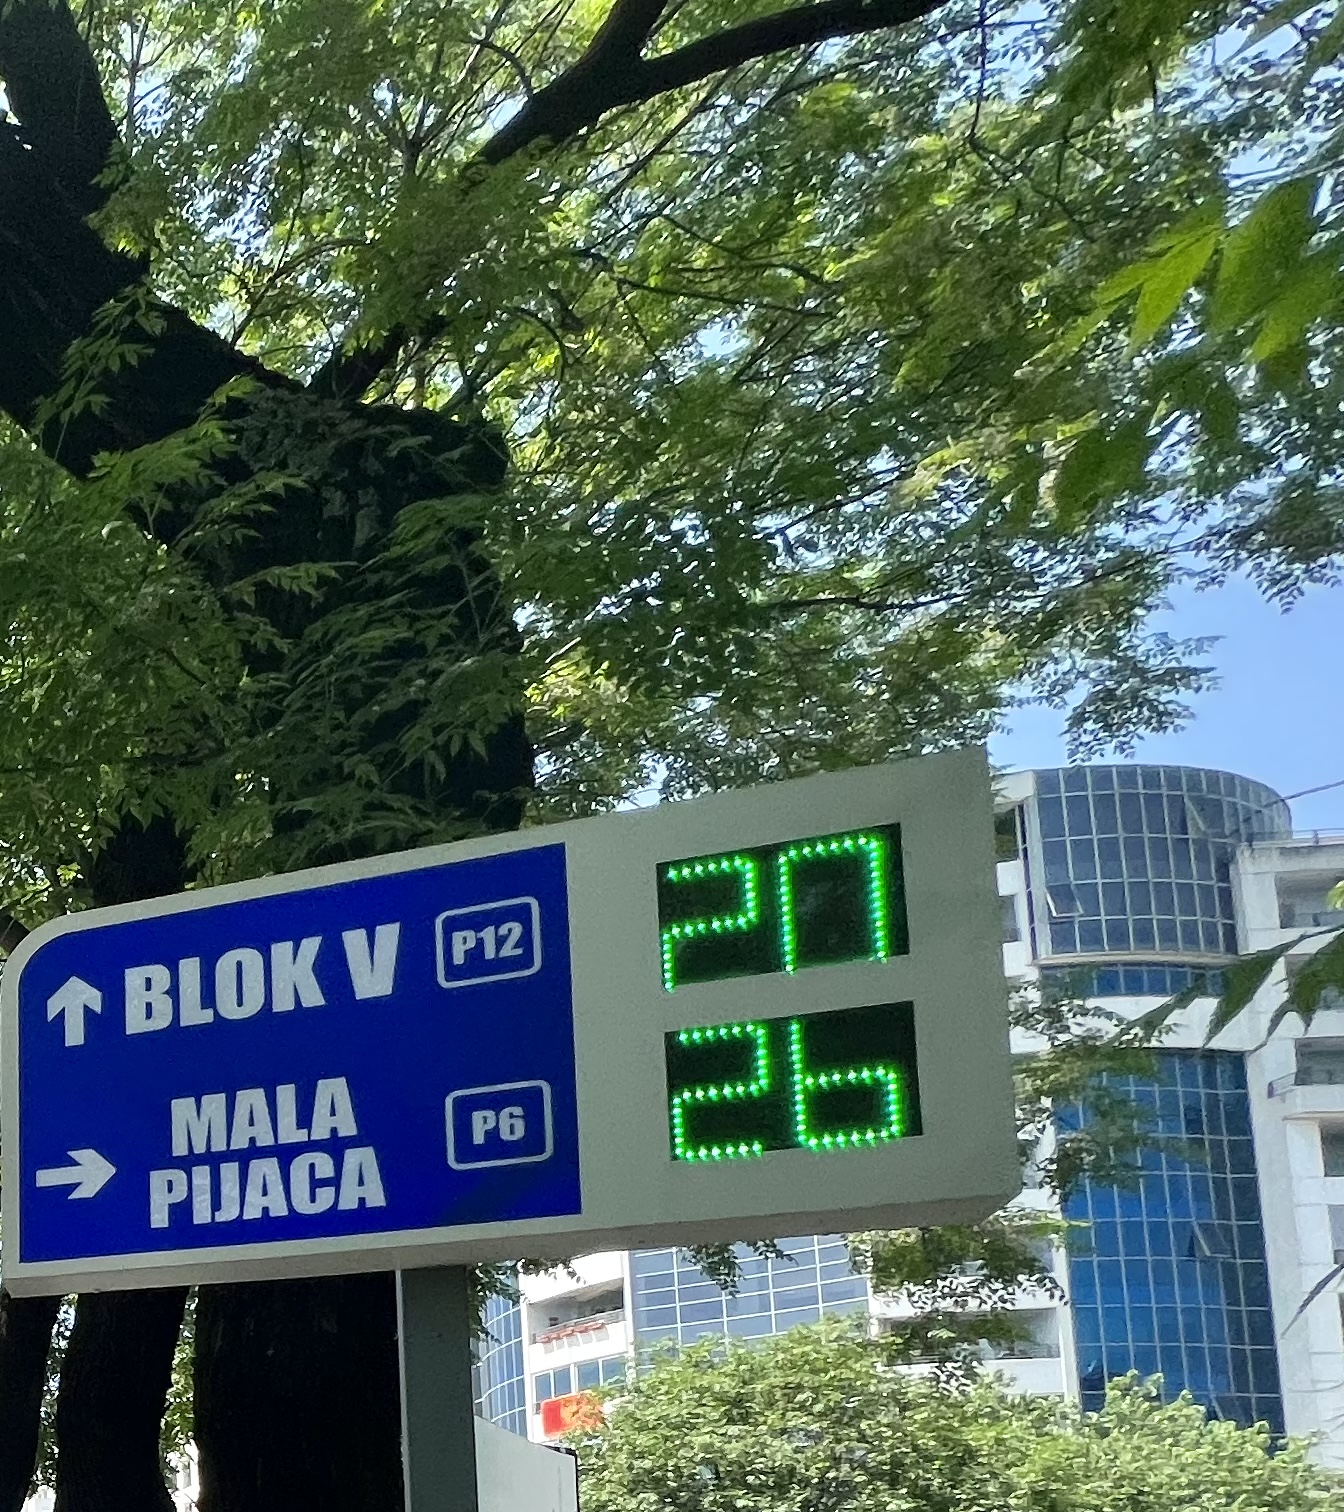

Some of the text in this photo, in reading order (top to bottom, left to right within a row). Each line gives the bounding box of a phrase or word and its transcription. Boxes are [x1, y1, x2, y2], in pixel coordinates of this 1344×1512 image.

[124, 921, 401, 1035] BLOK V
[452, 921, 524, 966] P12
[171, 1076, 358, 1157] MALA
[471, 1106, 526, 1145] P6
[671, 1019, 905, 1163] 26
[150, 1146, 387, 1229] PIJACA
